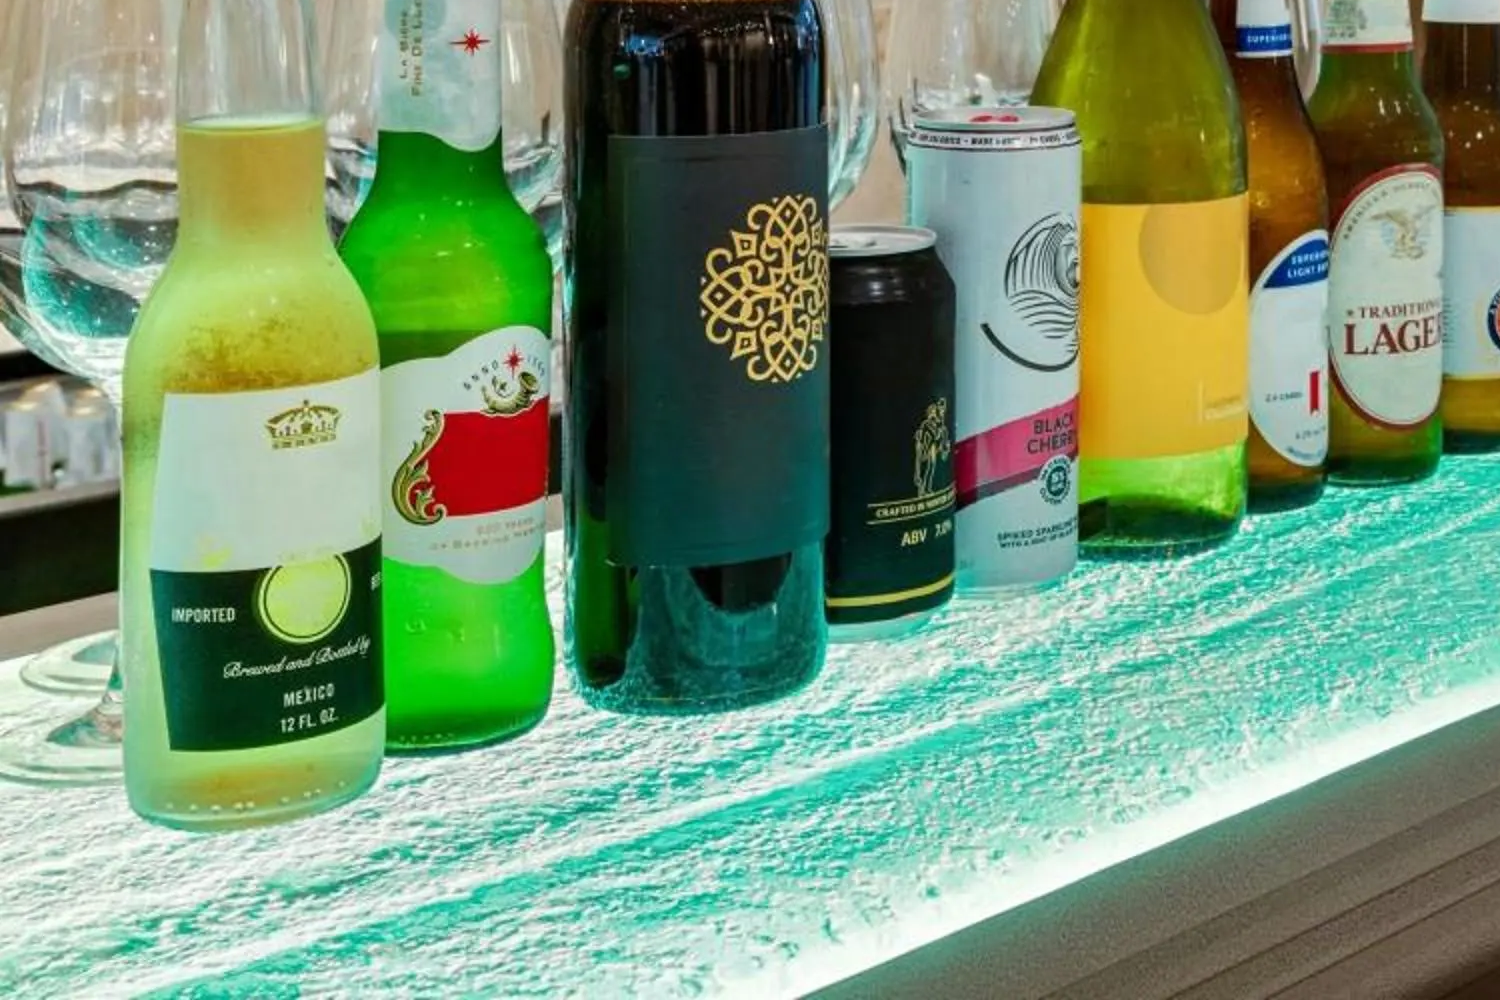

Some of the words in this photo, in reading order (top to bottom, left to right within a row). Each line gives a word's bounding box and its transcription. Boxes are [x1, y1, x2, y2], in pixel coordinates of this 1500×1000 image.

[876, 503, 917, 519] CRAFTED
[901, 527, 928, 548] ABV
[171, 606, 236, 624] IMPORTED
[223, 655, 286, 680] Brewed
[286, 651, 316, 672] and
[283, 682, 336, 709] MEXICO
[280, 717, 295, 734] 12
[299, 713, 317, 731] FL.
